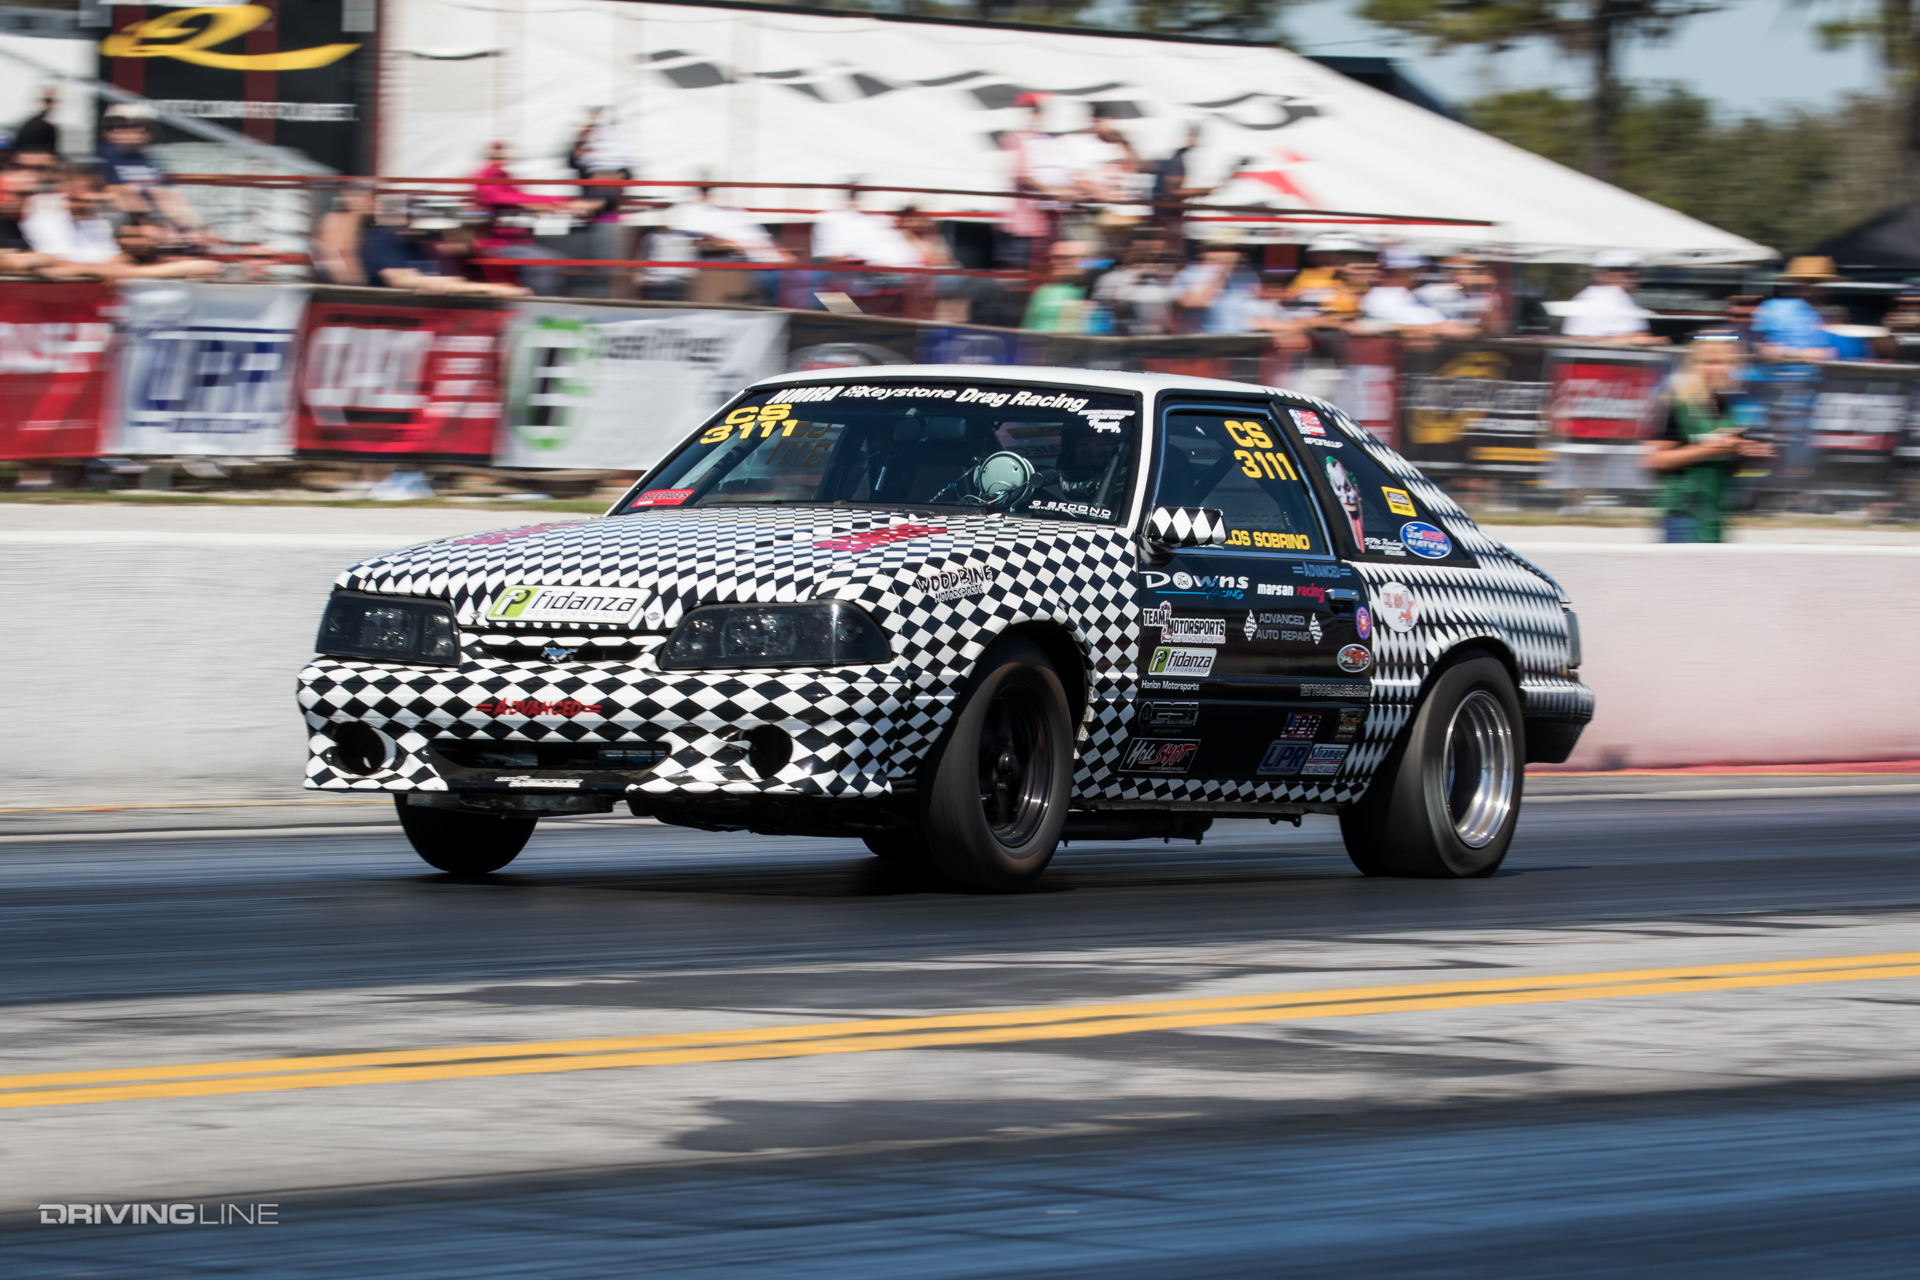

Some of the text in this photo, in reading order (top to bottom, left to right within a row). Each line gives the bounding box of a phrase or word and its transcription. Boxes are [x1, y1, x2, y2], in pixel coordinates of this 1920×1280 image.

[766, 386, 1089, 412] NMRA Keystone Drag Racing
[725, 403, 792, 425] CS
[700, 419, 798, 444] 3111
[1224, 420, 1273, 448] CS
[1233, 449, 1298, 480] 3111
[1047, 501, 1111, 516] SECOND
[1253, 531, 1310, 550] SOBRINO
[1407, 539, 1448, 552] NATION
[916, 564, 993, 594] WOODBINE
[532, 590, 638, 612] fidanza
[935, 584, 983, 603] MOTORSPORTS
[1257, 583, 1324, 603] marsan racing
[1143, 609, 1166, 626] TEAM
[1167, 619, 1225, 635] MOTORSPORTS
[1259, 613, 1305, 625] ADVANCED
[1256, 629, 1311, 641] AUTO REPAIR
[1167, 651, 1212, 668] fidanza
[1141, 680, 1199, 692] Hanlon Motorsports
[1262, 746, 1307, 767] UPR
[1308, 745, 1345, 760] Strange
